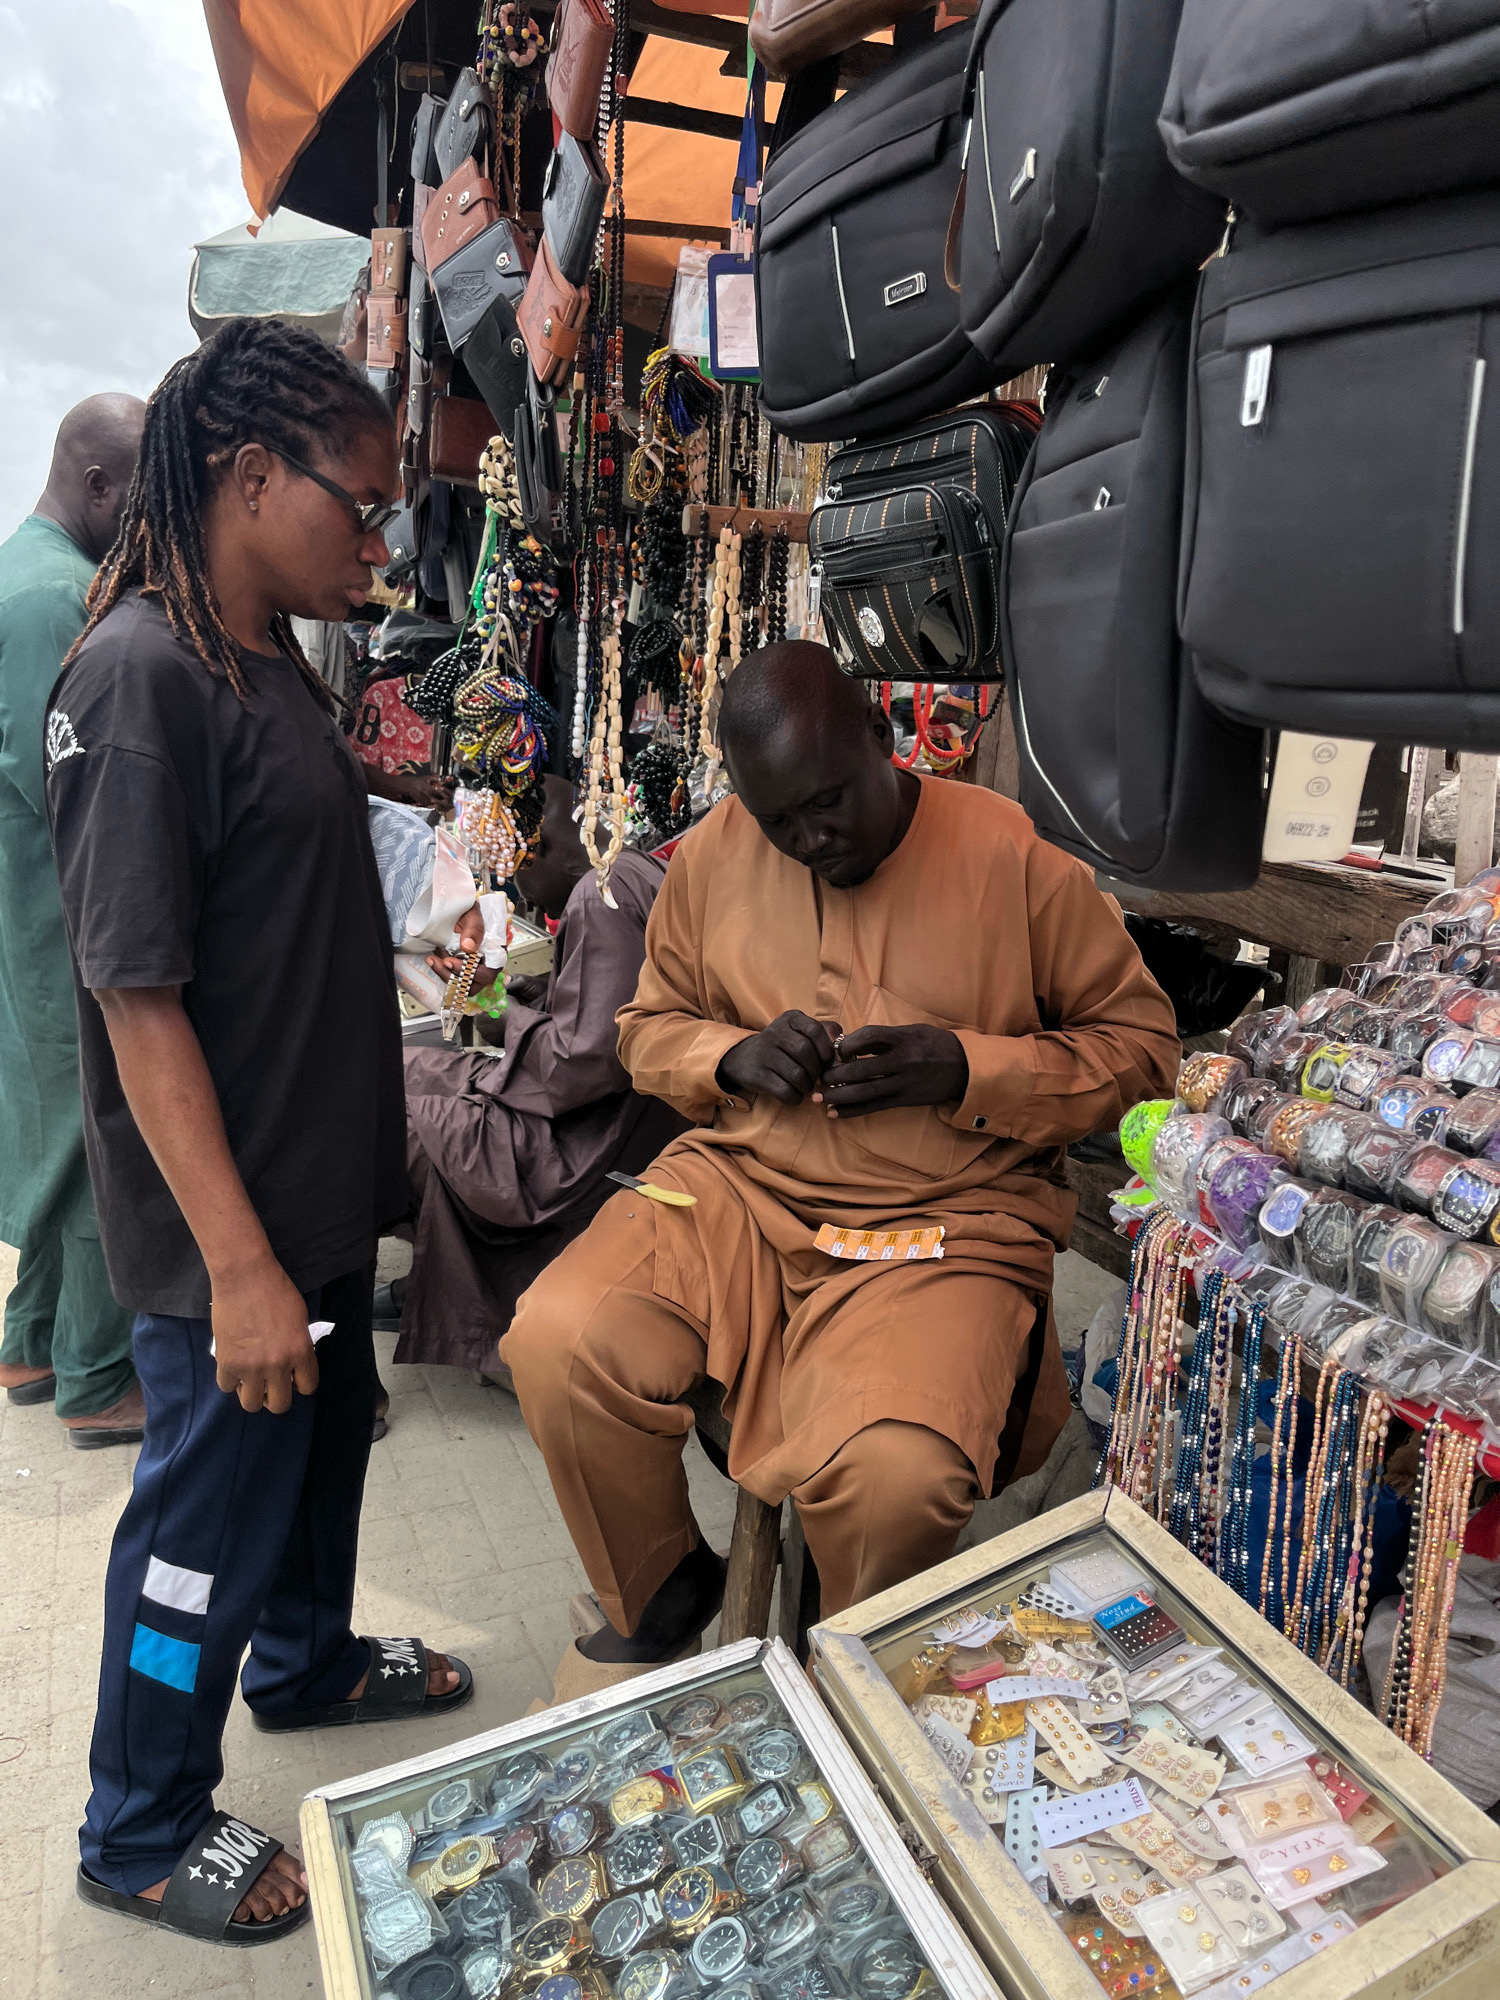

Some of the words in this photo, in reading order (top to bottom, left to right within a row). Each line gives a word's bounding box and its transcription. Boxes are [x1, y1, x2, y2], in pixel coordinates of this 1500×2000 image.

[1100, 1605, 1122, 1620] Nose
[1114, 1602, 1136, 1618] Stud
[1156, 1756, 1176, 1773] Y&M
[1181, 1771, 1201, 1788] Y&M
[1128, 1787, 1145, 1810] STEEL
[201, 1820, 270, 1878] DIOR
[1278, 1836, 1326, 1859] YTJX
